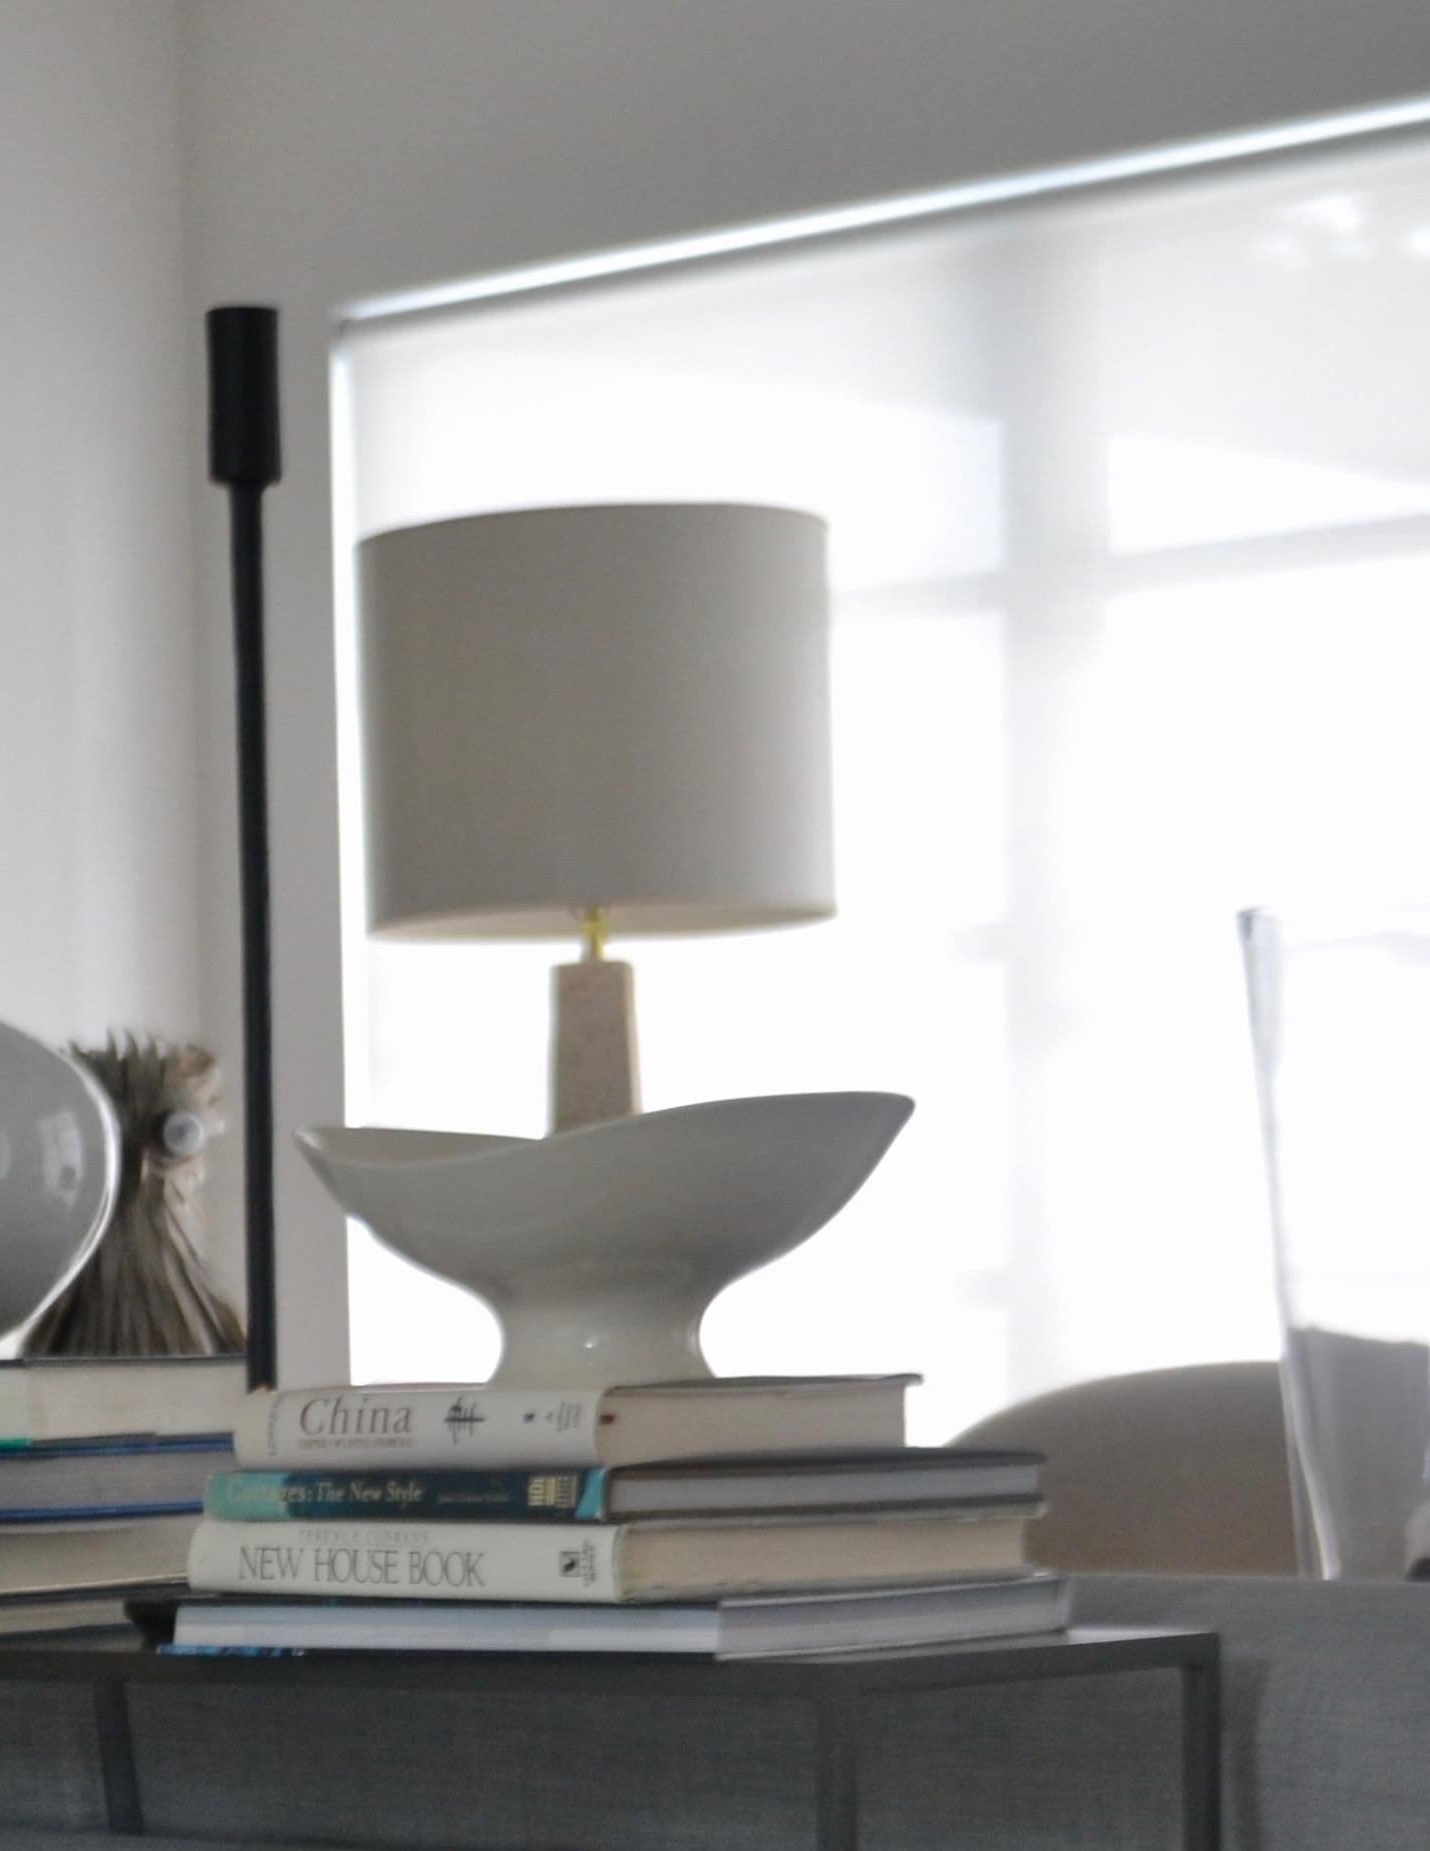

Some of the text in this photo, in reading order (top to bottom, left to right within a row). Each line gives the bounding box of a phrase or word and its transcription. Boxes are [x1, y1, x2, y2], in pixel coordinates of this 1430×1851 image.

[299, 1394, 412, 1436] China
[316, 1481, 346, 1503] The
[350, 1480, 382, 1503] New
[385, 1477, 423, 1510] Style
[238, 1545, 487, 1588] NEW HOUSE BOOK
